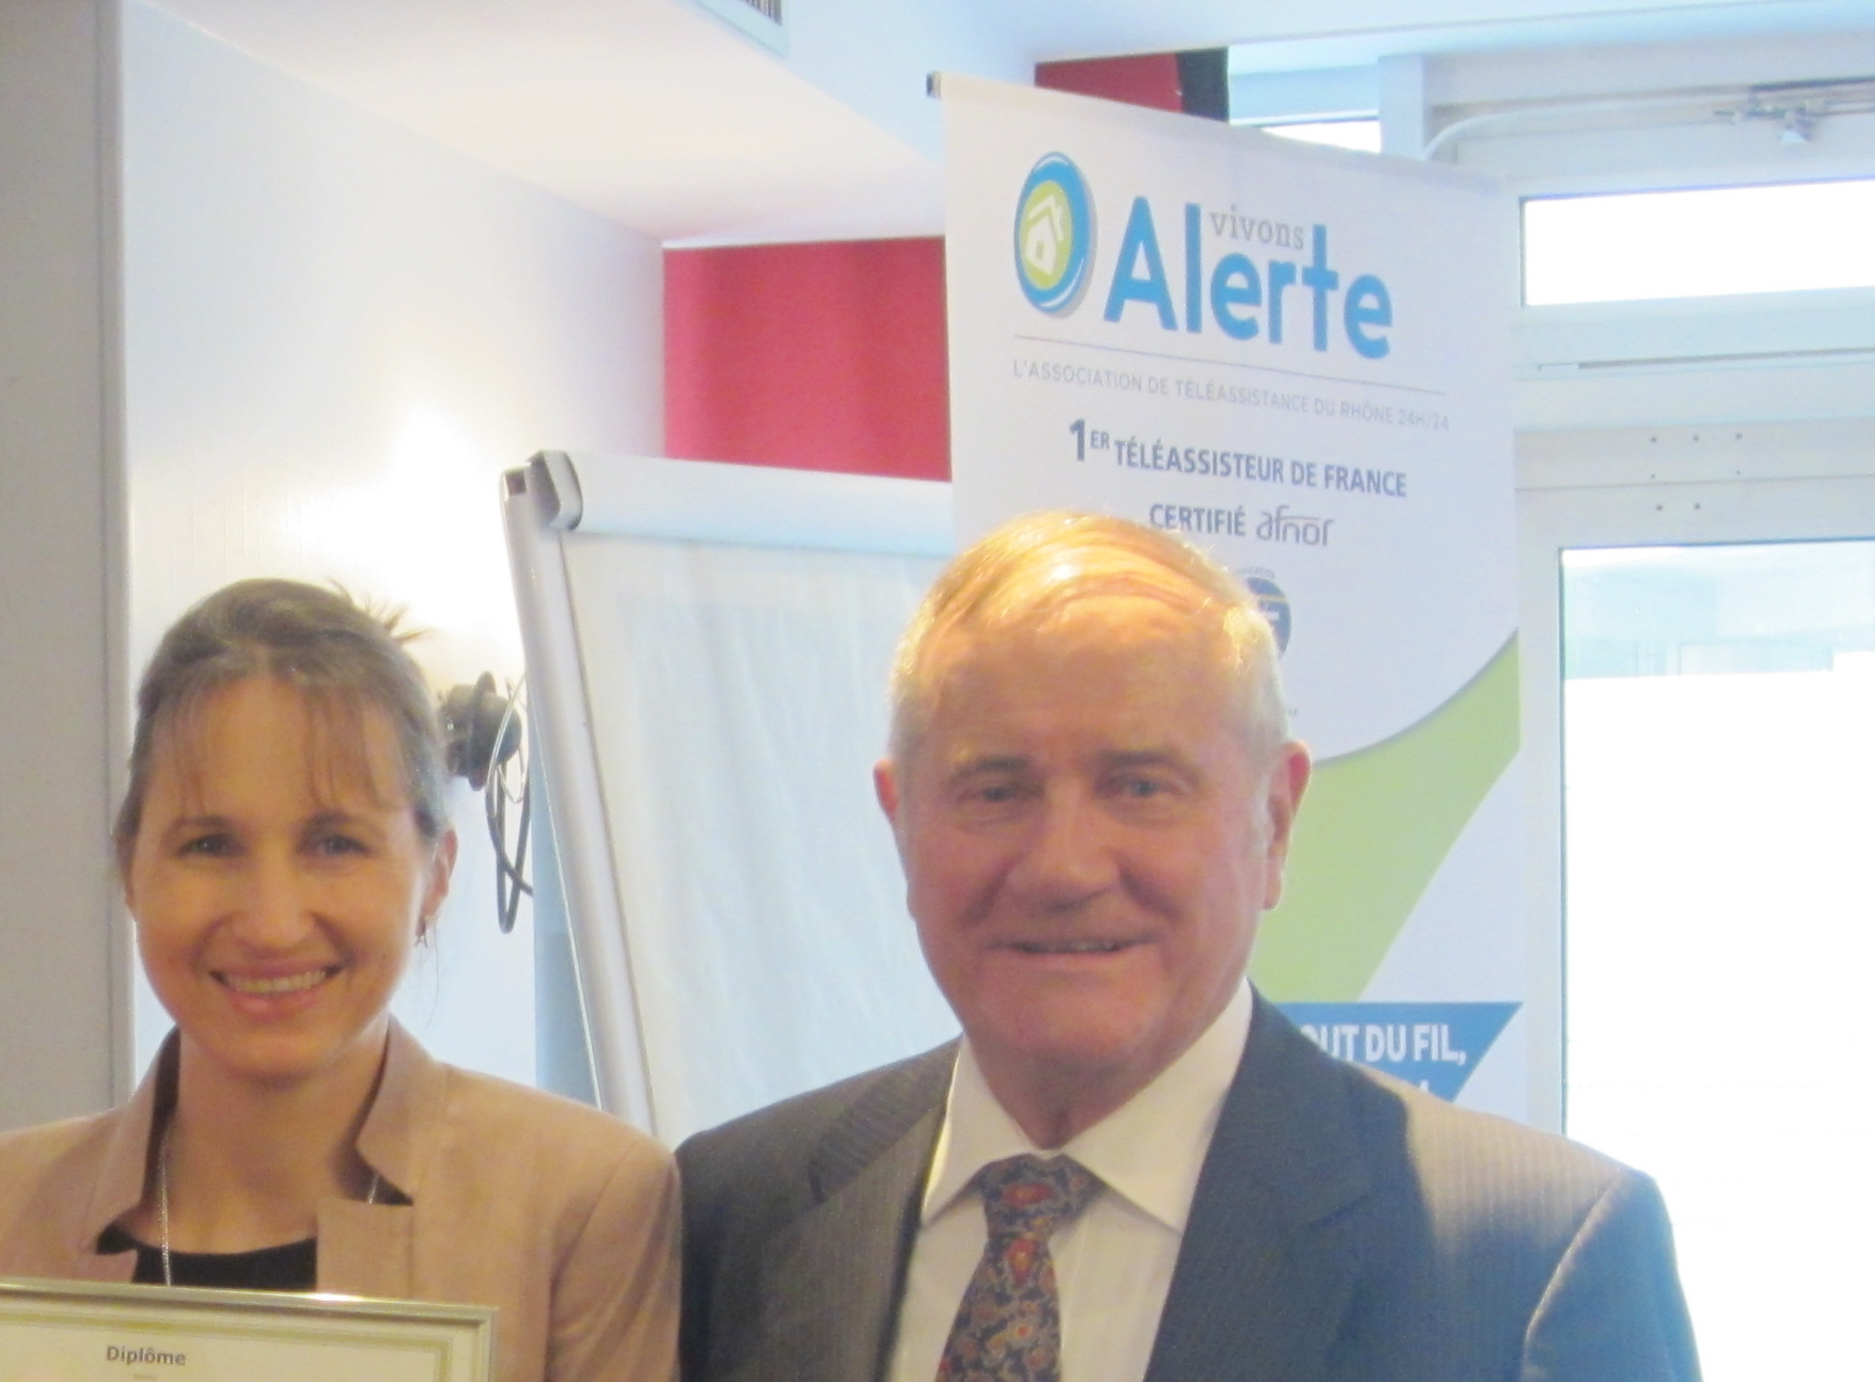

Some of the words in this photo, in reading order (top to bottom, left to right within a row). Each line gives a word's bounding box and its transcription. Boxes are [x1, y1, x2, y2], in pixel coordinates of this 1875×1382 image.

[1209, 203, 1305, 250] vivons
[1103, 195, 1393, 359] Alerte
[1013, 358, 1142, 392] L'ASSOCIATION
[1147, 376, 1168, 395] DE
[1174, 377, 1308, 413] TÉLÉASSISTANCE
[1314, 398, 1335, 416] DU
[1340, 400, 1393, 424] RHÔNE
[1114, 435, 1284, 484] TÉLÉASSISTEUR
[1291, 459, 1317, 487] DE
[1324, 463, 1407, 497] FRANCE
[1149, 503, 1246, 537] CERTIFIÉ
[1256, 504, 1335, 546] afnor
[1365, 1024, 1407, 1062] DU
[1413, 1023, 1467, 1066] FIL,
[106, 1345, 186, 1366] Diplôme
